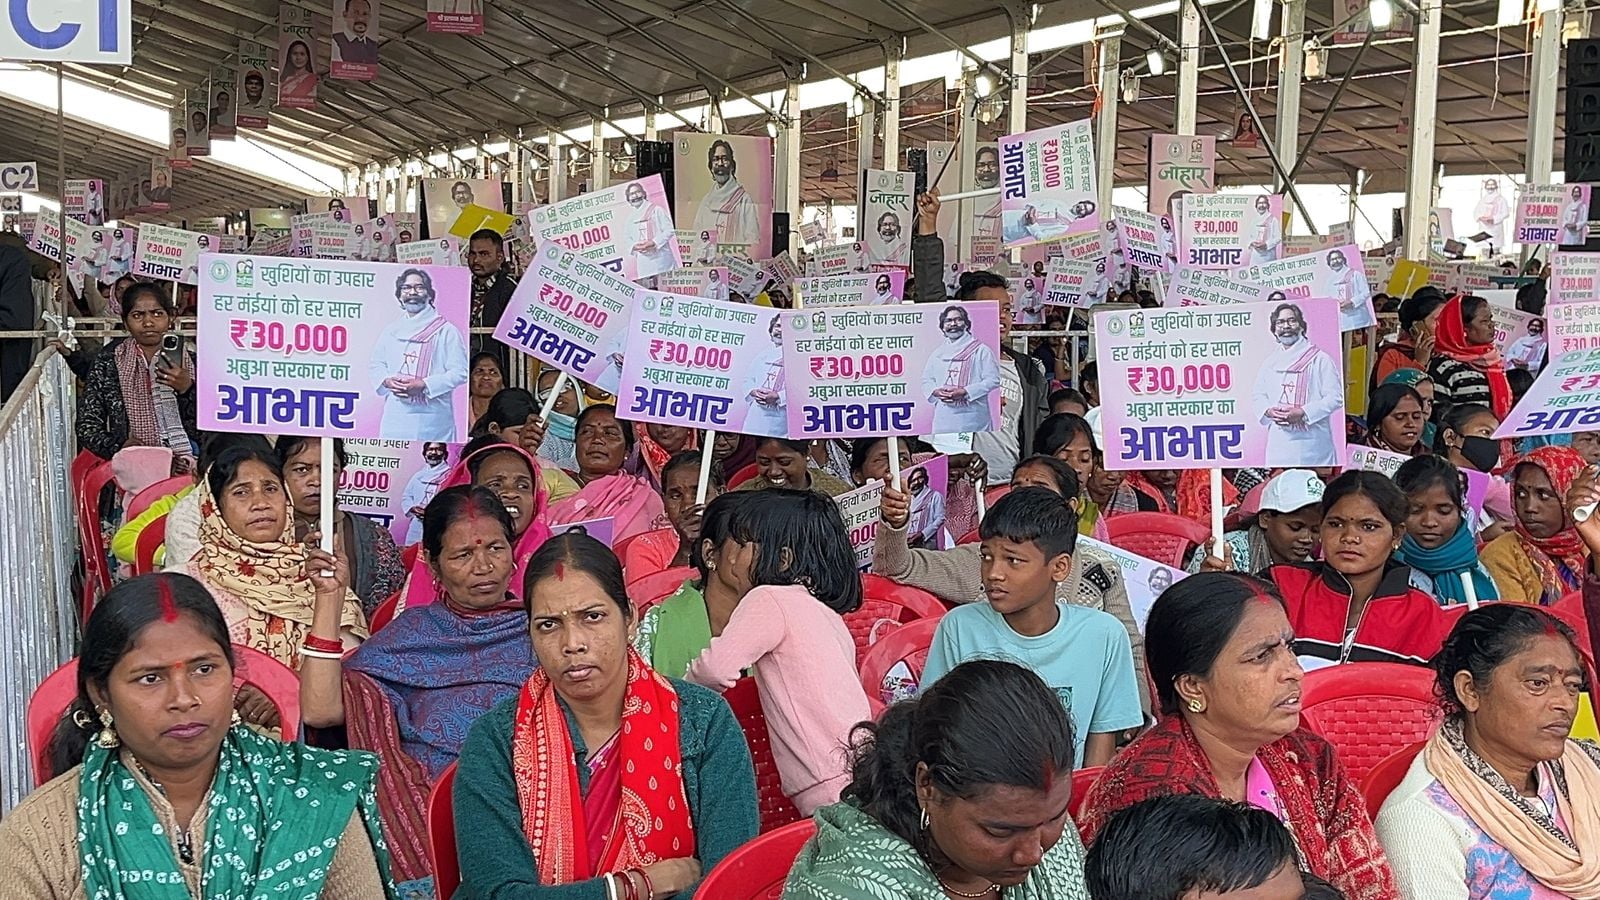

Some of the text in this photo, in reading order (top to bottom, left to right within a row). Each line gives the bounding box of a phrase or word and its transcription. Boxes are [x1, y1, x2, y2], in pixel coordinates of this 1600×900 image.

[283, 22, 314, 39] जोहार
[241, 55, 268, 71] जोहार
[1003, 141, 1026, 199] आभार
[1043, 139, 1061, 188] ₹30,000
[1, 165, 36, 190] C2
[1157, 162, 1210, 189] जोहार
[560, 192, 615, 217] खुशियों का उपहार
[869, 189, 910, 211] जोहार
[1226, 196, 1233, 204] का
[1233, 196, 1248, 205] उपहार
[1188, 210, 1196, 218] हर
[1213, 209, 1221, 217] को
[1230, 210, 1243, 218] साल
[541, 228, 551, 240] हर
[572, 216, 583, 229] को
[583, 215, 594, 226] हर
[595, 210, 613, 222] साल
[1194, 221, 1238, 235] ₹30,000
[1520, 227, 1559, 241] आभार
[147, 243, 182, 256] ₹30,000
[605, 245, 616, 255] का
[1193, 237, 1209, 247] अबुआ
[1211, 237, 1231, 245] सरकार
[1127, 247, 1163, 268] आभार
[1189, 248, 1242, 265] आभार
[1287, 260, 1296, 268] का
[140, 261, 183, 279] आभार
[261, 264, 375, 288] खुशियों का उपहार
[575, 261, 605, 282] खुशियों
[604, 276, 616, 288] का
[615, 281, 635, 298] उपहा
[1295, 272, 1314, 283] साल
[538, 265, 624, 314] हर मंईयां को हर साल
[1046, 290, 1081, 304] आभार
[1176, 285, 1187, 294] हर
[1209, 290, 1220, 303] को
[1203, 275, 1261, 297] खुशियों का उपहार
[213, 293, 362, 318] हर मंईयां को हर साल
[539, 283, 608, 329] ₹30,000
[678, 302, 757, 325] खुशियों का उपहार
[526, 304, 599, 345] अबुआ सरकार का
[831, 311, 923, 330] खुशियों का उपहार
[1150, 311, 1251, 333] खुशियों का उपहार
[231, 320, 347, 354] ₹30,000
[641, 320, 745, 346] हर मंईयां को हर साल
[795, 335, 913, 353] हर मंईयां को हर साल
[508, 317, 596, 372] आभार
[650, 339, 732, 370] ₹30,000
[1111, 339, 1241, 361] हर मंईयां को हर साल
[227, 358, 350, 381] अबुआ सरकार का
[810, 354, 902, 380] ₹30,000
[643, 367, 730, 390] अबुआ सरकार का
[1128, 364, 1230, 395] ₹30,000
[809, 383, 906, 401] अबुआ सरकार का
[217, 385, 359, 429] आभार
[631, 386, 733, 424] आभार
[1127, 400, 1235, 422] अबुआ सरकार का
[803, 402, 914, 433] आभार
[1121, 424, 1245, 461] आभार
[362, 455, 375, 467] हर
[378, 457, 400, 468] साल
[338, 470, 389, 490] 0,000
[338, 494, 389, 508] सरकार का
[861, 490, 871, 501] का
[856, 510, 868, 523] हर
